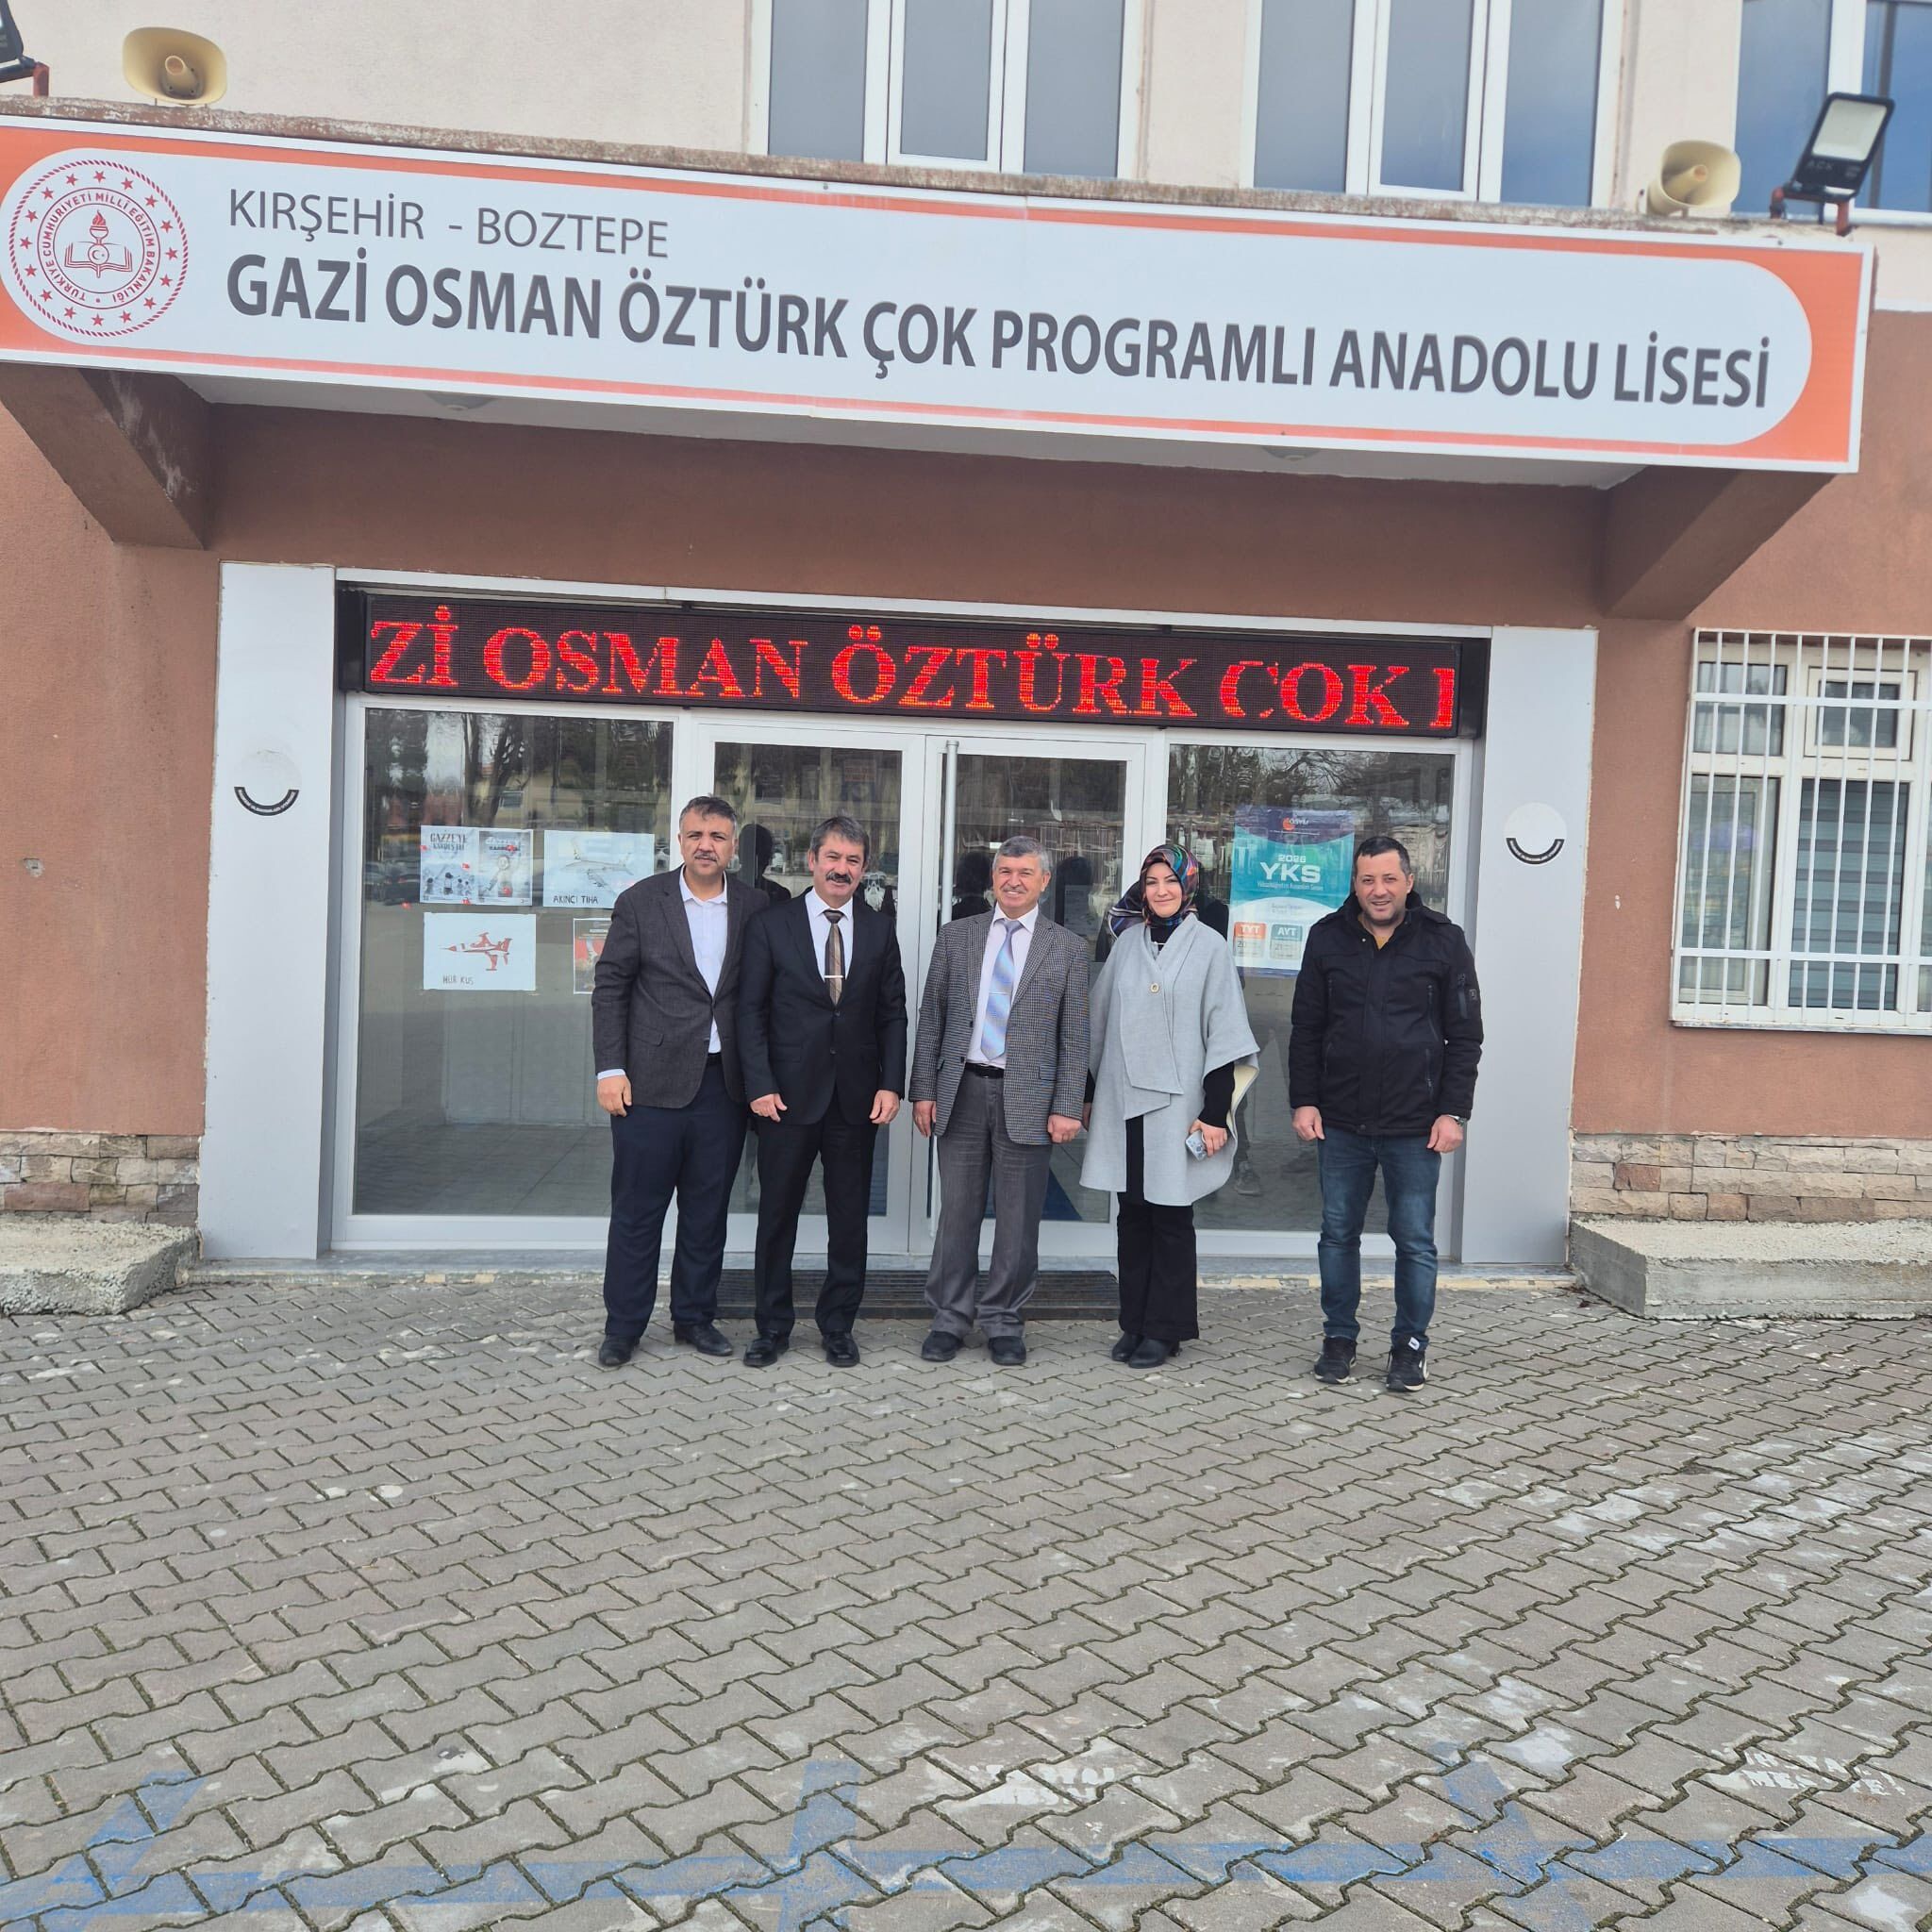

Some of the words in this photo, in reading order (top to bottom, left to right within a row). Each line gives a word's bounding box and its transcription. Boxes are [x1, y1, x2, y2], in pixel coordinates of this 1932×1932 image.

[43, 192, 92, 256] CUMHURİYETİ
[129, 208, 155, 246] EĞİTİM
[230, 188, 425, 242] KIRŞEHİR
[477, 207, 669, 258] BOZTEPE
[45, 260, 86, 302] TÜRKİYE
[112, 251, 156, 303] BAKANLIĞI
[227, 246, 368, 323] GAZİ
[385, 264, 602, 340] OSMAN
[619, 267, 849, 358] ÖZTÜRK
[863, 301, 977, 380] ÇOK
[991, 309, 1316, 386] PROGRAMLI
[1328, 329, 1599, 400] ANADOLU
[1613, 330, 1771, 408] LİSESİ
[370, 605, 458, 688] Zİ
[482, 626, 808, 699] OSMAN
[830, 624, 1197, 719] ÖZTÜRK
[1259, 861, 1321, 884] YKS
[1277, 927, 1297, 936] AYT
